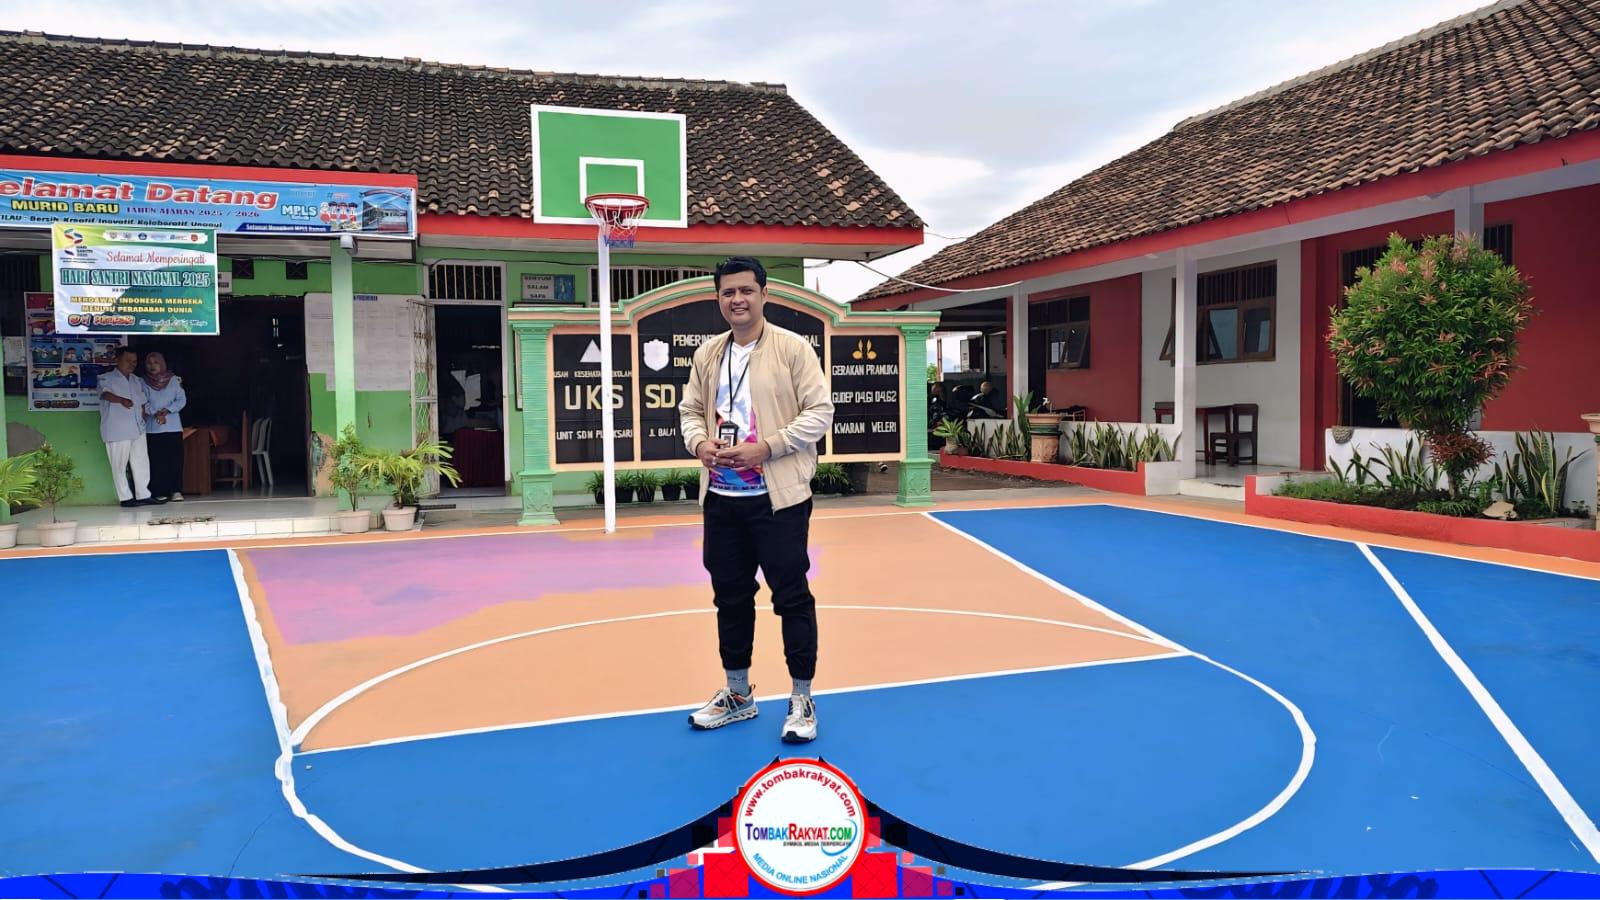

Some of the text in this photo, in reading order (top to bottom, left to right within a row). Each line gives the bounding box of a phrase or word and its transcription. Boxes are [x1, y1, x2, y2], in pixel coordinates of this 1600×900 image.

[146, 183, 278, 209] Datang
[11, 199, 120, 213] MURID BARU
[281, 205, 317, 216] MPLS
[106, 251, 143, 263] Selamat
[146, 253, 206, 268] Memperingati
[61, 269, 90, 285] HARI
[92, 270, 129, 286] SANTRI
[131, 270, 181, 287] NASIONAL
[183, 272, 211, 288] 2025
[673, 357, 692, 367] DINA
[832, 365, 898, 376] GERAKAN PRAMUKA
[564, 385, 624, 410] UKS
[645, 384, 676, 408] SD
[834, 422, 897, 434] KWARAN WELERI
[556, 431, 573, 440] UNIT
